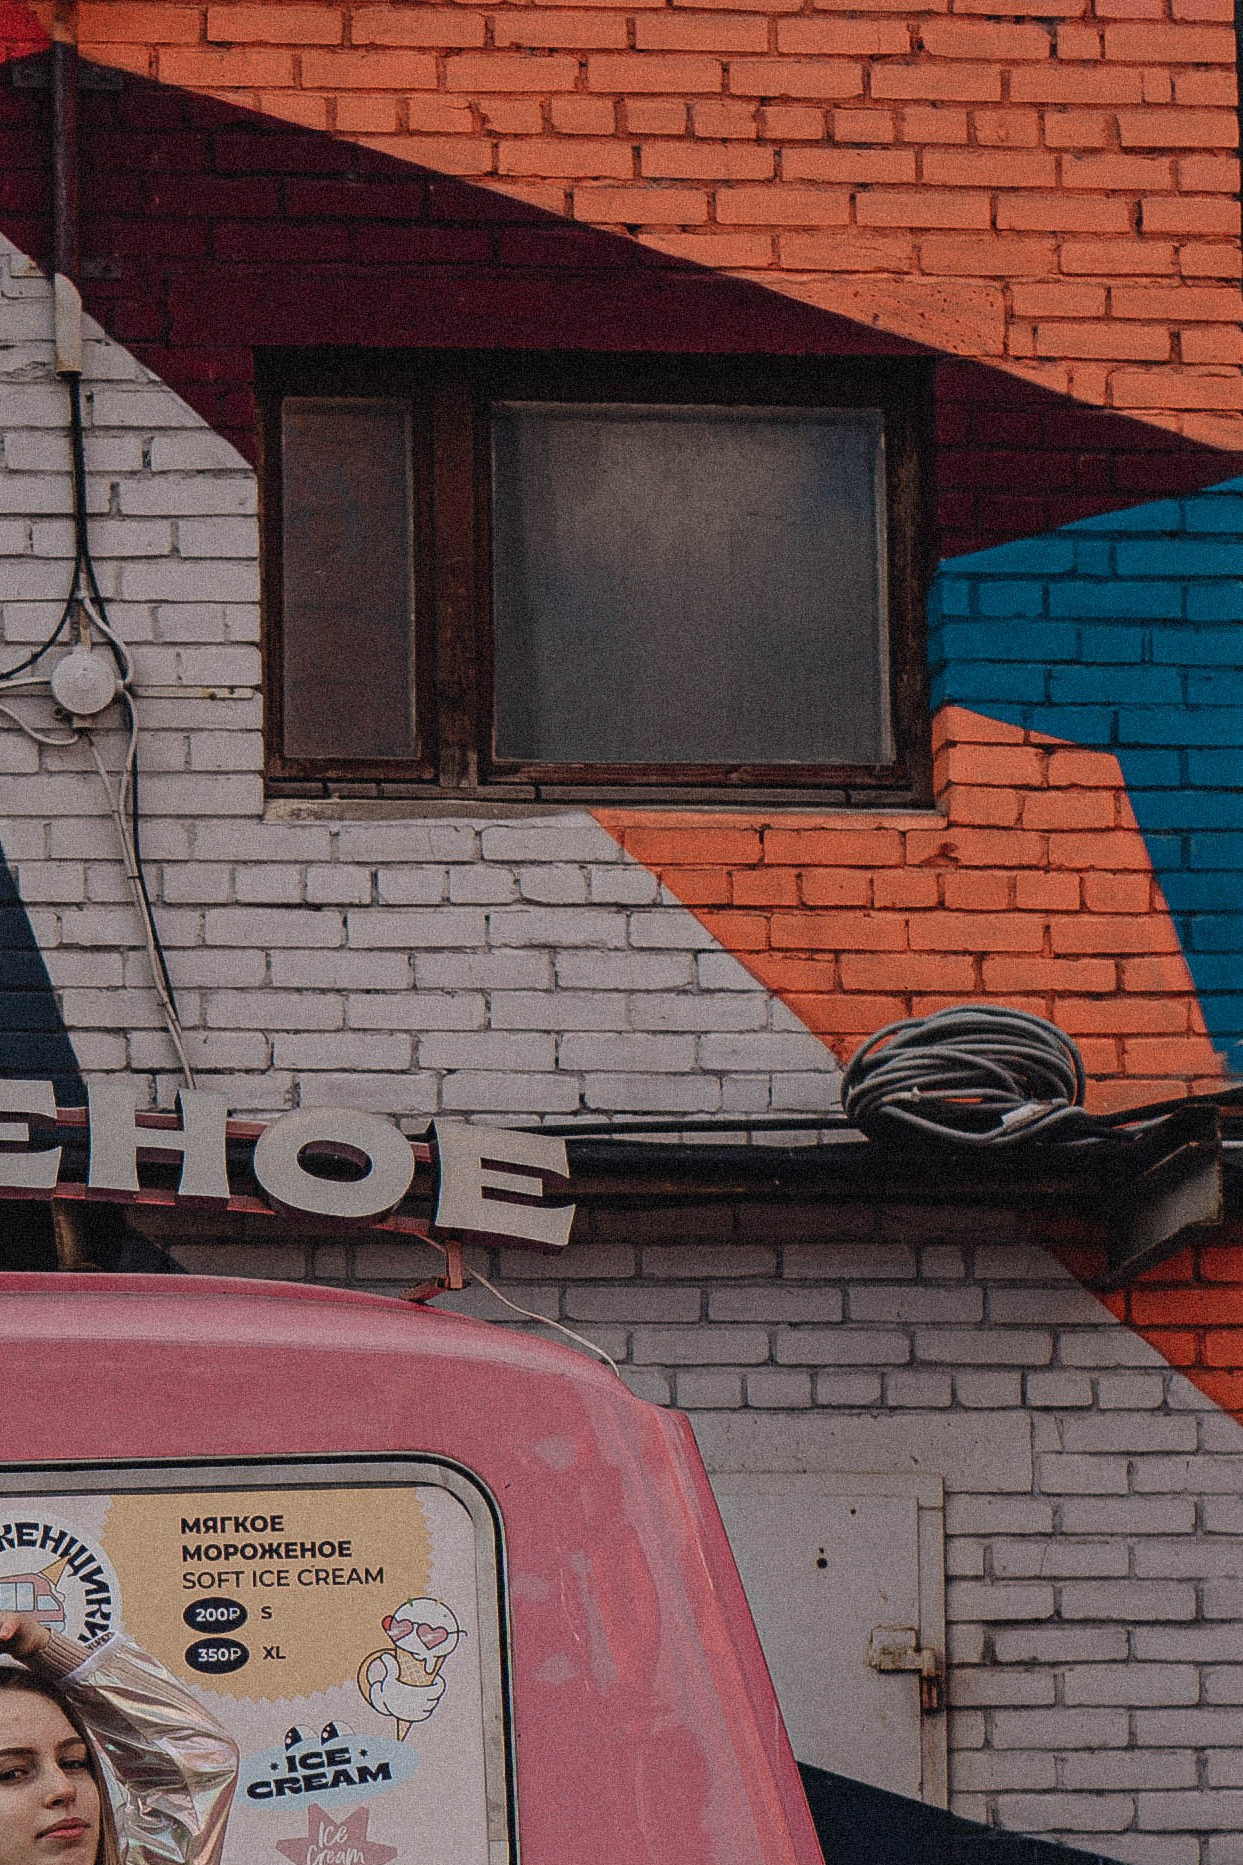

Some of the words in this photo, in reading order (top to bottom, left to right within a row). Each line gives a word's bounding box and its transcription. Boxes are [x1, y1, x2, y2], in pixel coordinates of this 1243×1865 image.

[180, 1515, 285, 1534] МЯГКОЕ
[181, 1540, 353, 1562] МОРОЖЕНОЕ
[182, 1571, 245, 1590] SOFT
[252, 1570, 290, 1588] ICE
[297, 1567, 384, 1587] CREAM
[260, 1606, 273, 1620] S
[262, 1645, 287, 1660] XL
[285, 1747, 352, 1774] ICE
[246, 1762, 392, 1800] CREAM
[318, 1821, 348, 1848] Ice
